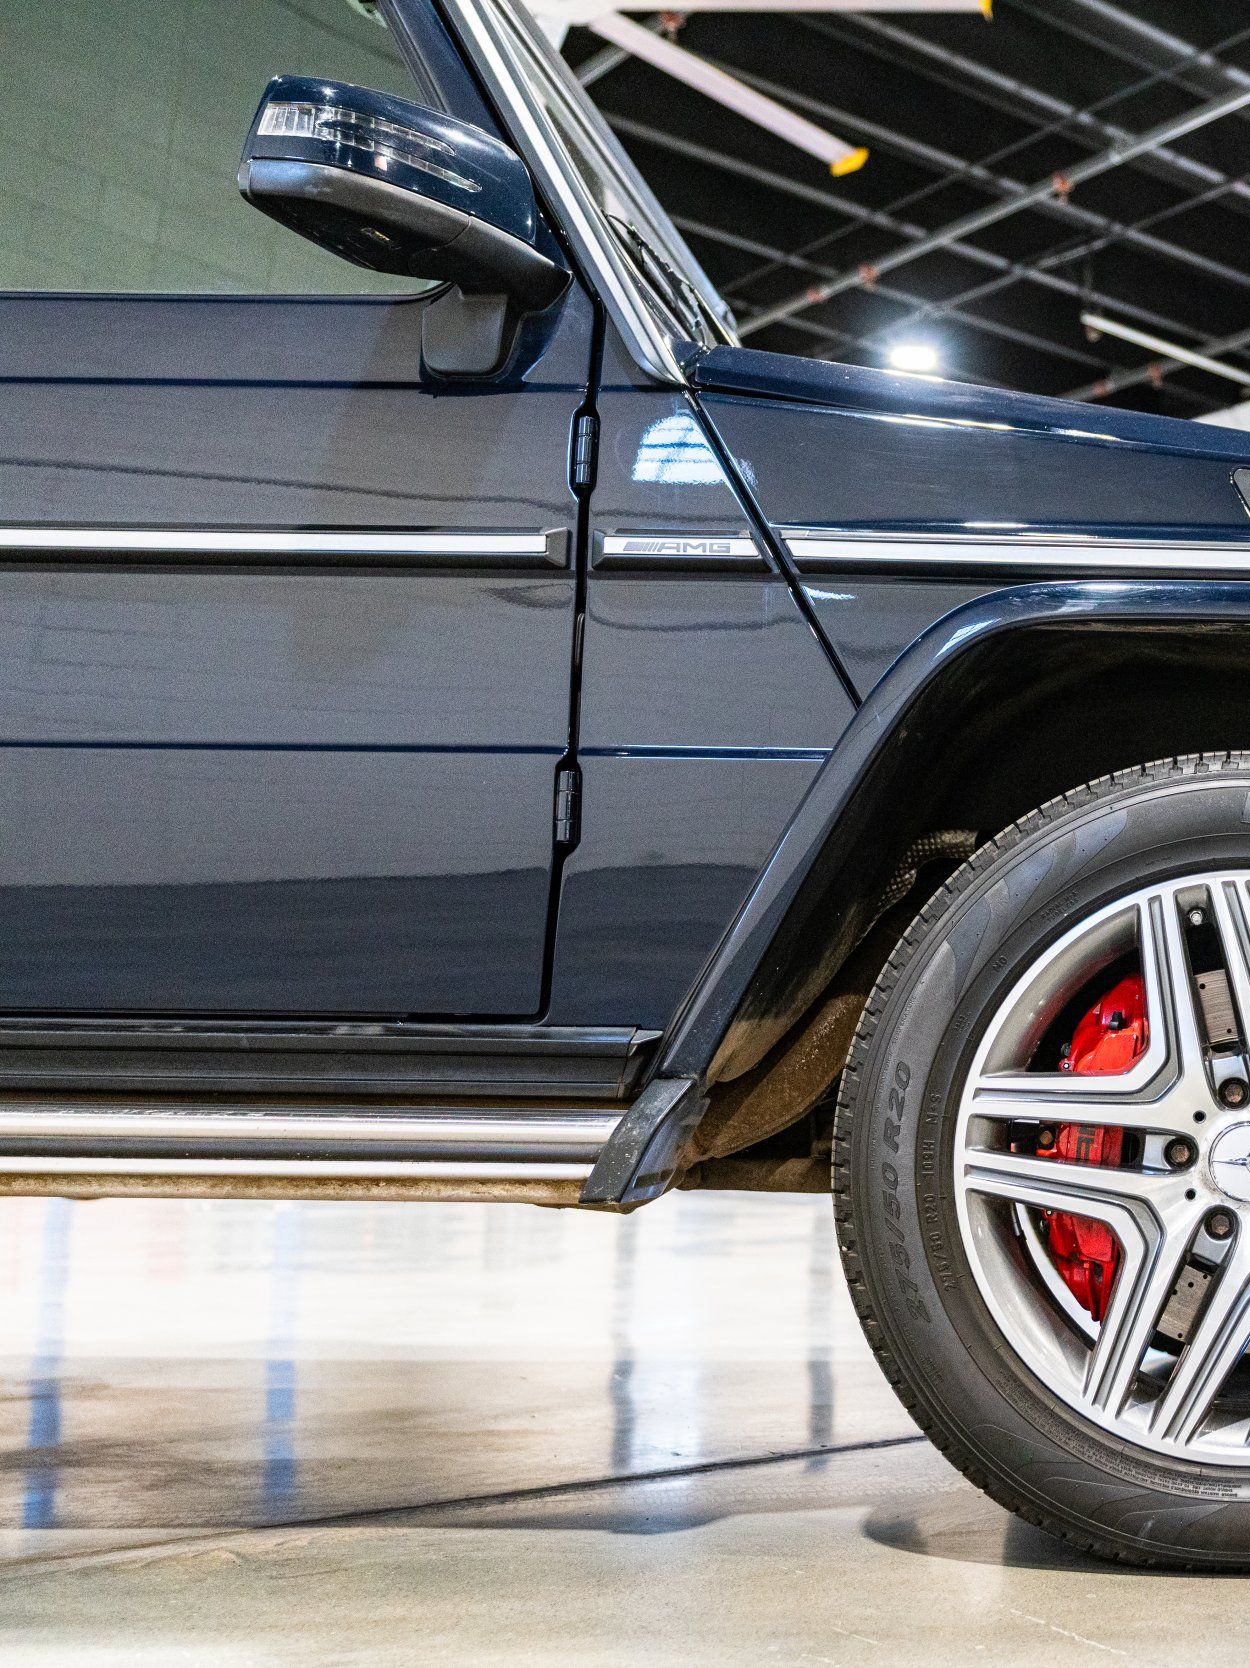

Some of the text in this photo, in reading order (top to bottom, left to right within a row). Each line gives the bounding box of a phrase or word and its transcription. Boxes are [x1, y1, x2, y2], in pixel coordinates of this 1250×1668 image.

[657, 541, 731, 554] AMG
[884, 1060, 912, 1154] R20
[881, 1160, 931, 1323] 275/50
